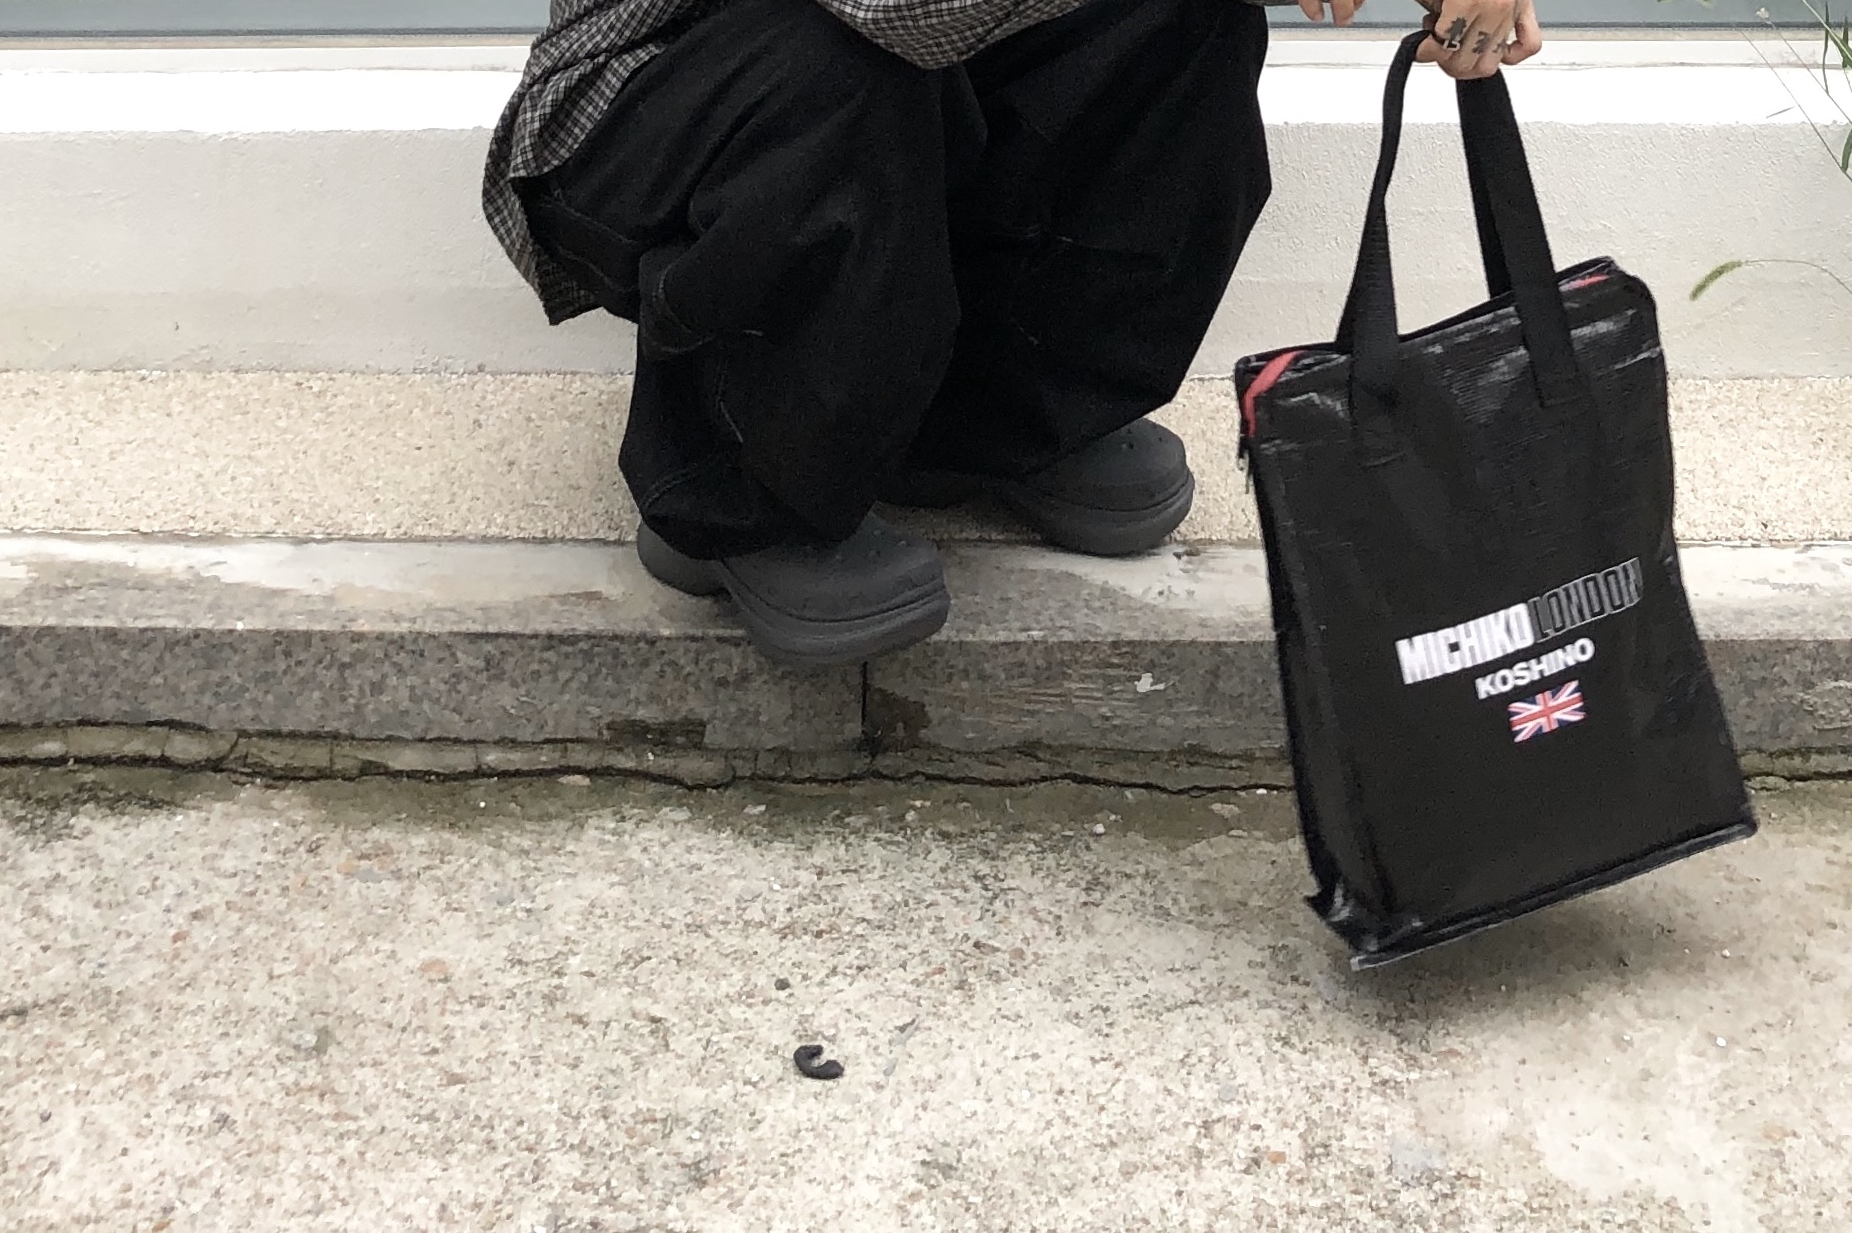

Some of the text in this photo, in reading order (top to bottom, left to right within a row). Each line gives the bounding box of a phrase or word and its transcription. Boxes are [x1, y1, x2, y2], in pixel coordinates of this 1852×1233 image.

[1395, 556, 1643, 685] MICHIKO LONDON
[1474, 637, 1596, 700] KOSHINO
